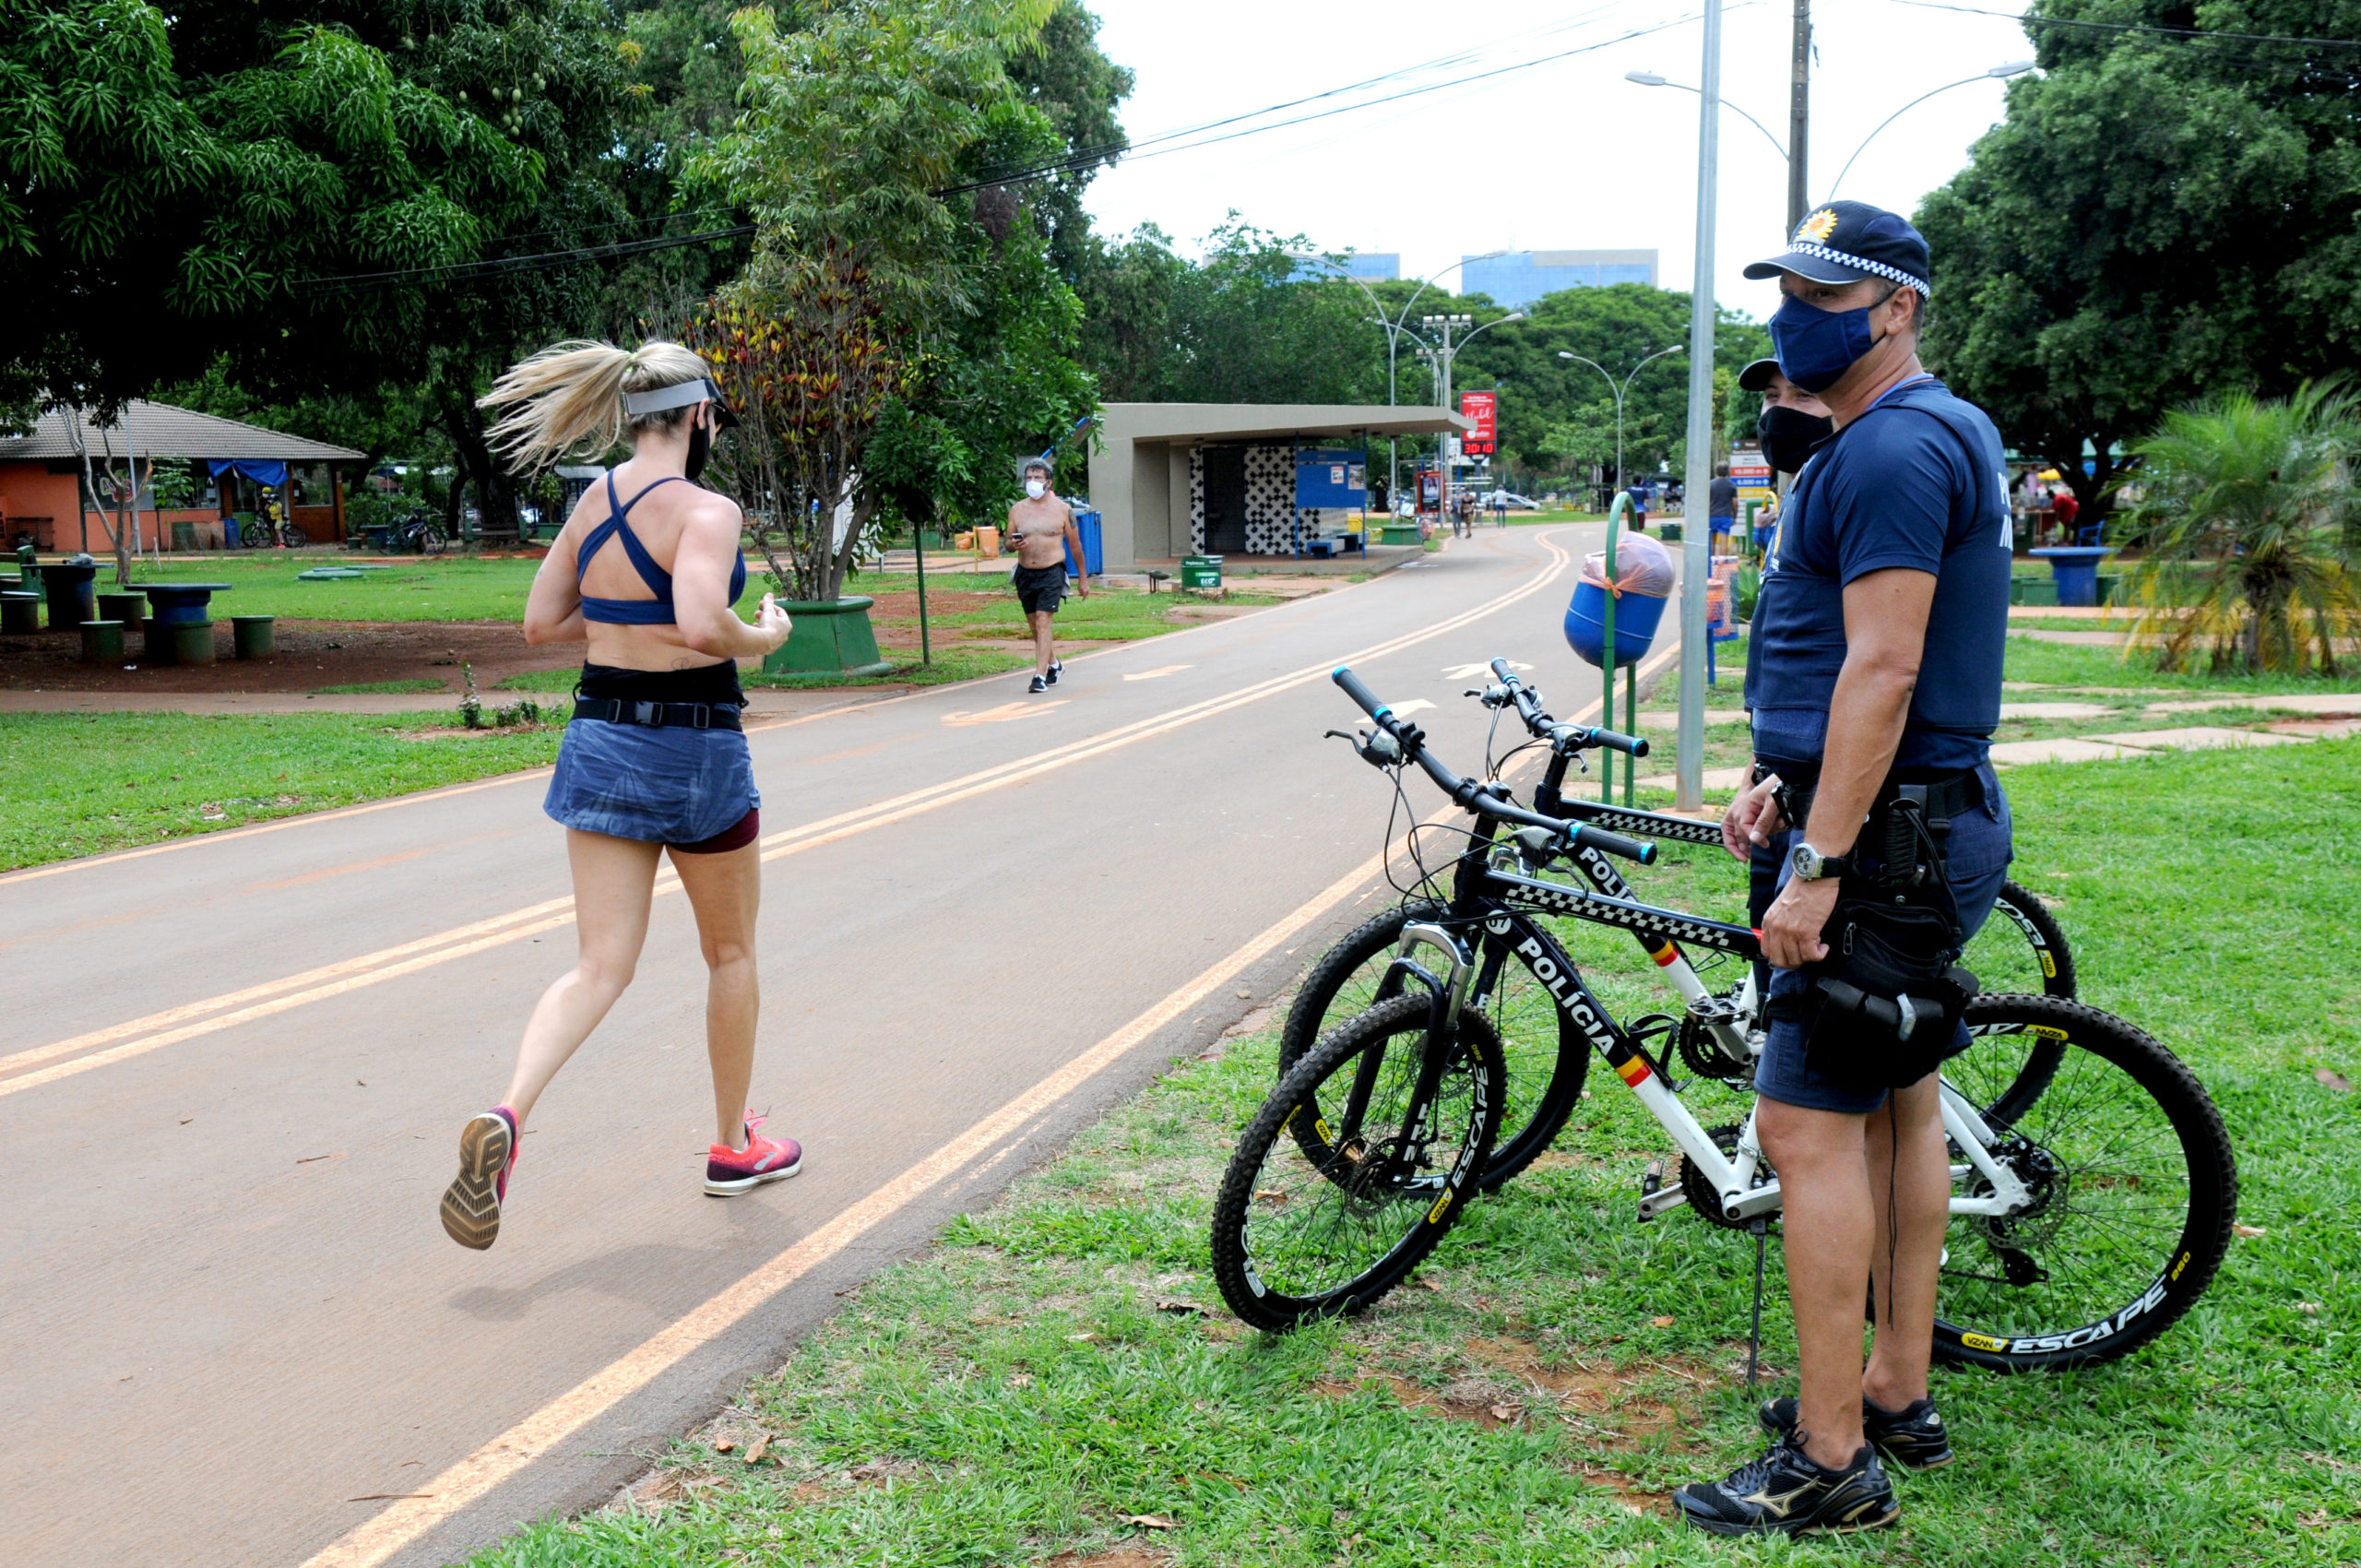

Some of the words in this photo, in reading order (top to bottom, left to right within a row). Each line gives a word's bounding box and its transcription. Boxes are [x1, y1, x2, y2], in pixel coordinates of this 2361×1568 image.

[1516, 935, 1616, 1057] POLÍCIA
[2035, 1026, 2064, 1040] VZAN
[1451, 1063, 1489, 1189] ESCAPE
[1432, 1200, 1449, 1219] VZAN
[2009, 1273, 2168, 1354] ESCAPE
[1966, 1336, 1994, 1350] VZAN
